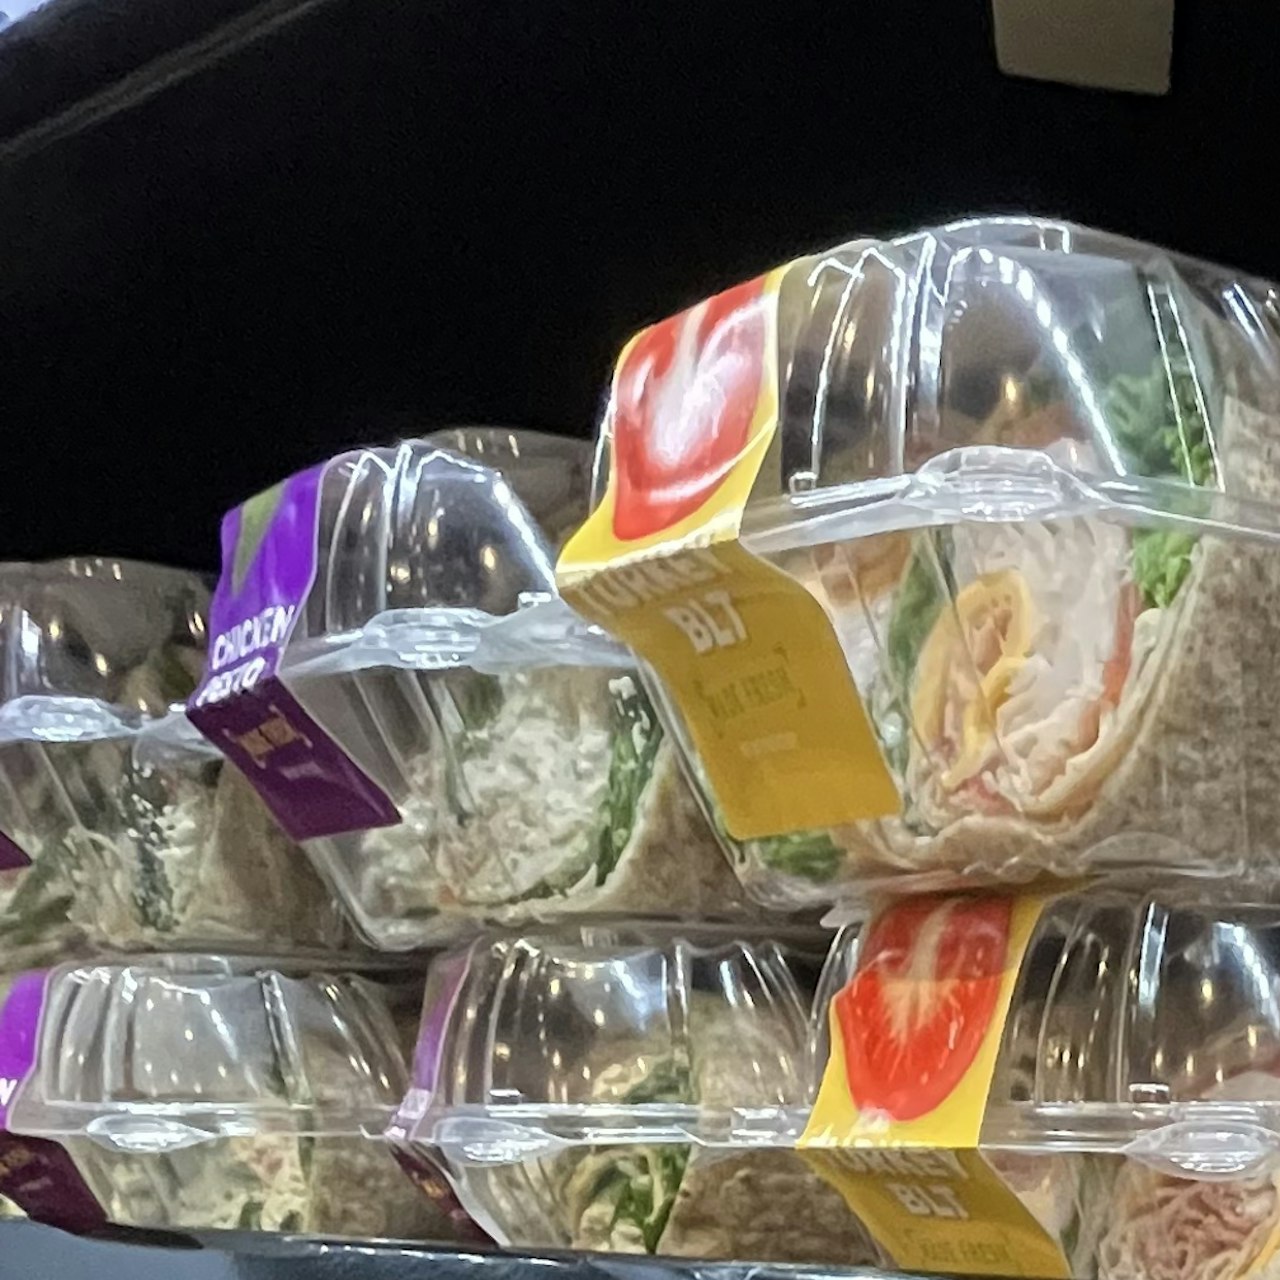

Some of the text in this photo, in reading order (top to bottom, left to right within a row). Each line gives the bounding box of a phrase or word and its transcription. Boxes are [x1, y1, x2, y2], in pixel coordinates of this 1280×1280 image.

[212, 604, 296, 670] CHICKEN
[663, 590, 748, 655] BLT
[885, 1183, 970, 1220] BLT
